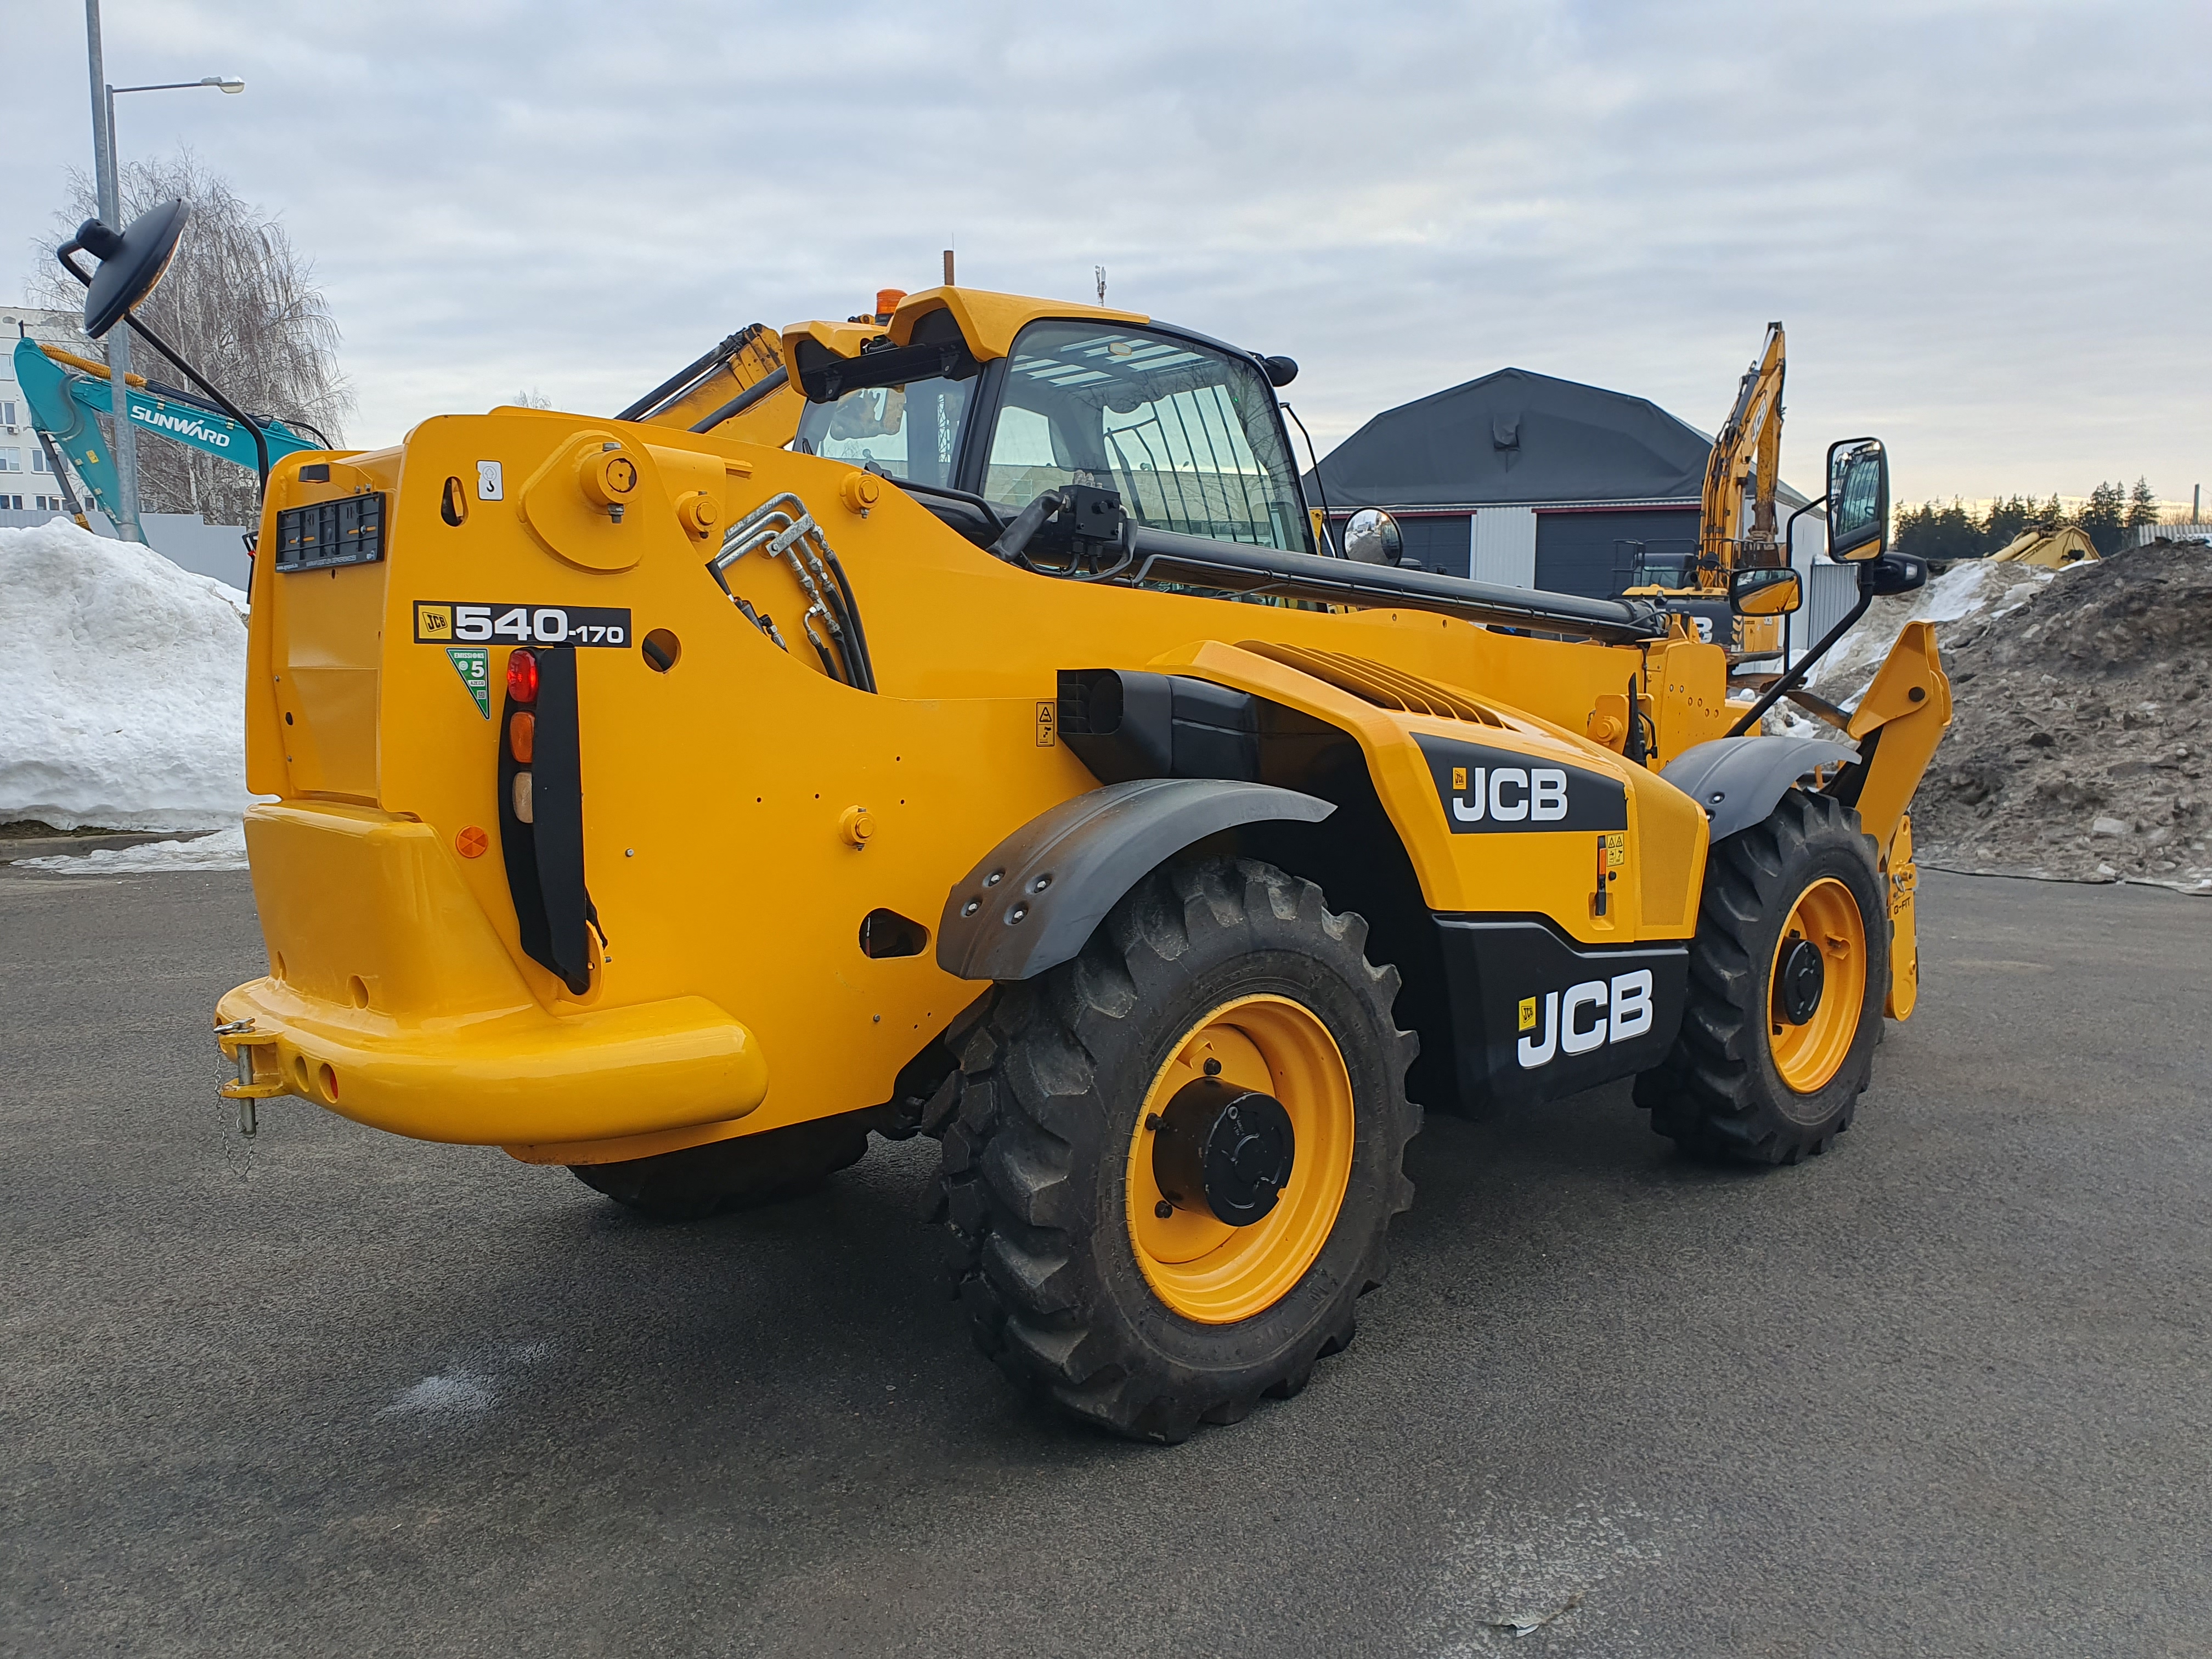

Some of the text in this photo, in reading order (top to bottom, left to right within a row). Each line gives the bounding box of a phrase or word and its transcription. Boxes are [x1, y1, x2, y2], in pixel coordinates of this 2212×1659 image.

[130, 405, 230, 447] SUNWARD
[1752, 399, 1767, 443] JCB
[426, 613, 447, 630] JCB
[455, 606, 624, 644] 540-170
[471, 661, 485, 678] 5
[1453, 768, 1568, 822] JCB
[1518, 969, 1653, 1069] JCB
[1522, 1006, 1533, 1021] JCB
